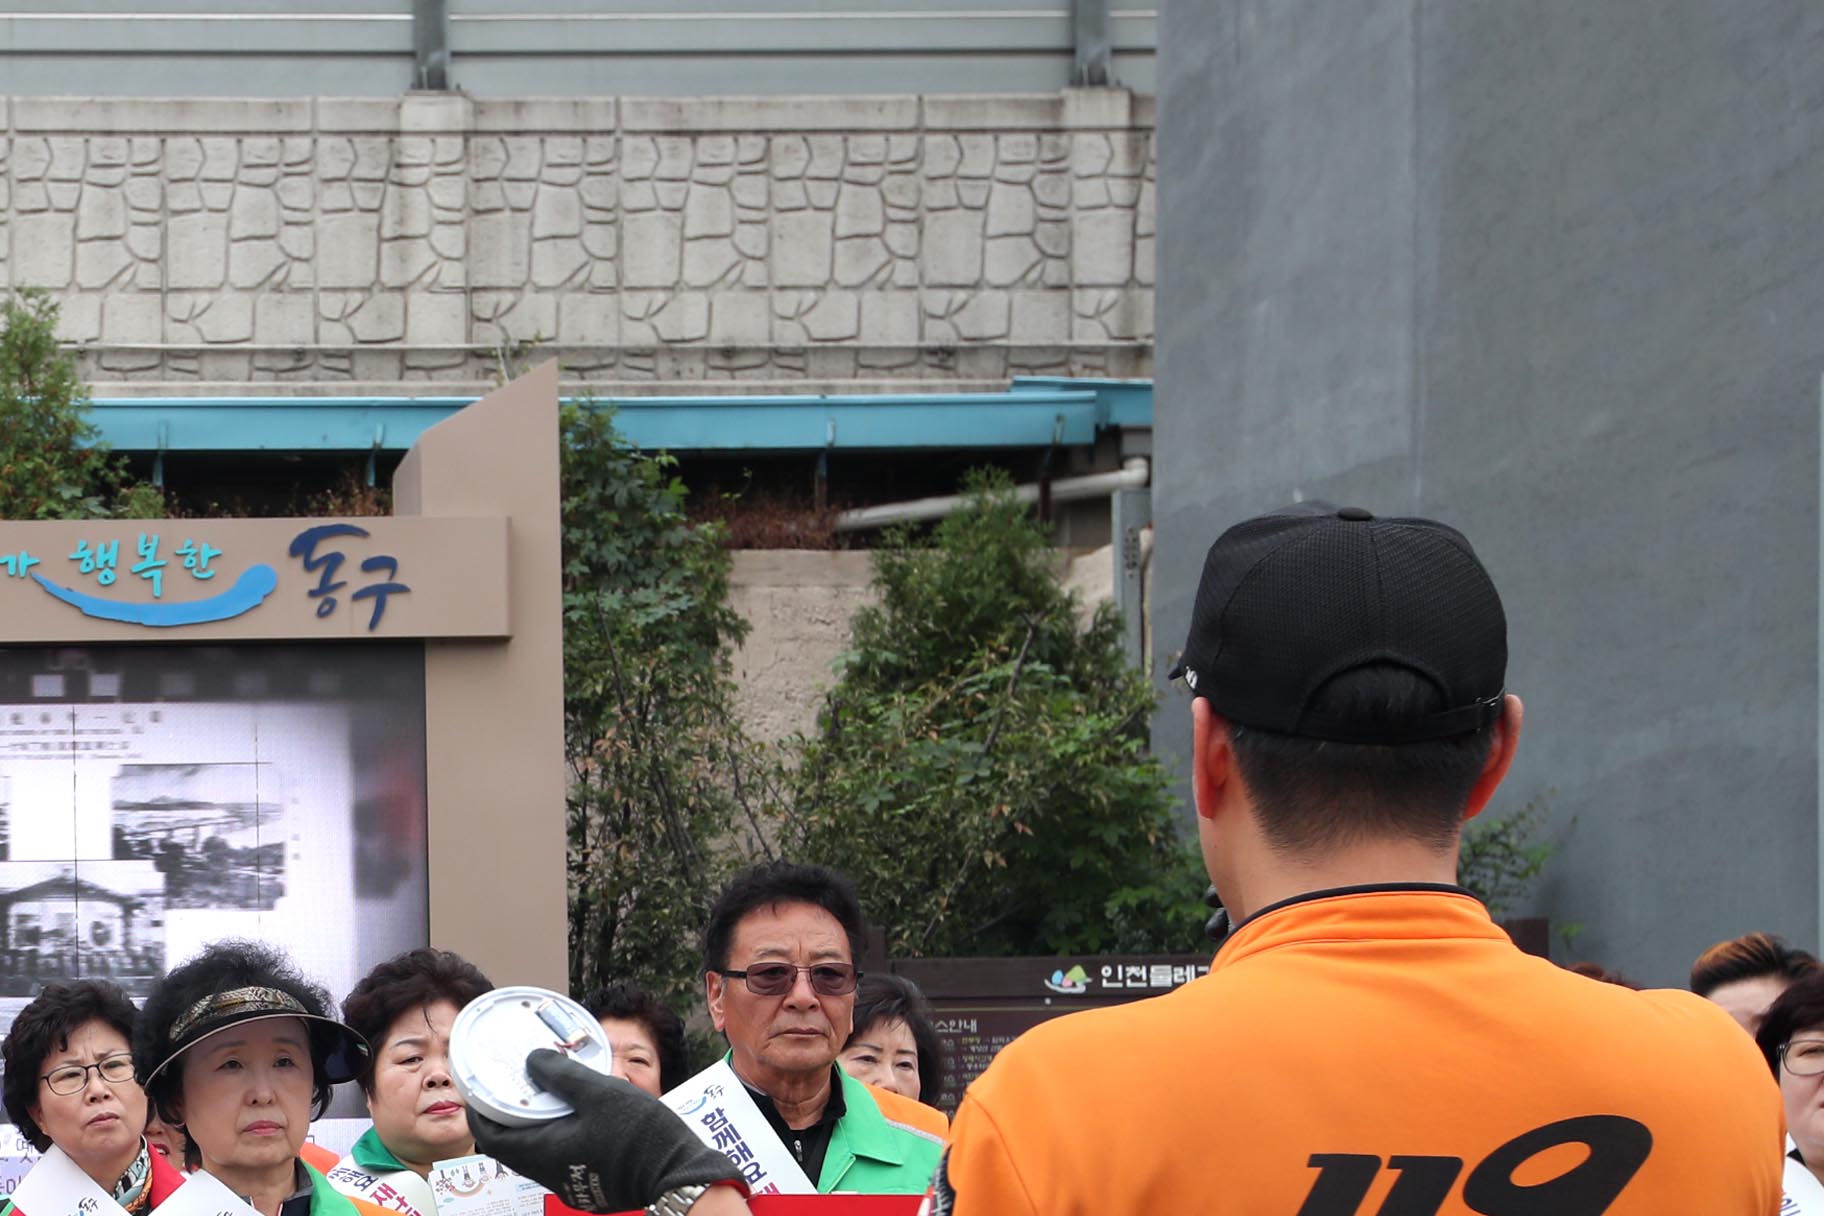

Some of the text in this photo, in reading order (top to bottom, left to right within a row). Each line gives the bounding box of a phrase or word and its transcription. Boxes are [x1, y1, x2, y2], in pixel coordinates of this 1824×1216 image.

[69, 533, 222, 598] 행복한
[289, 523, 412, 632] 동구
[930, 1018, 978, 1033] 스안내
[701, 1107, 767, 1185] 함께해요
